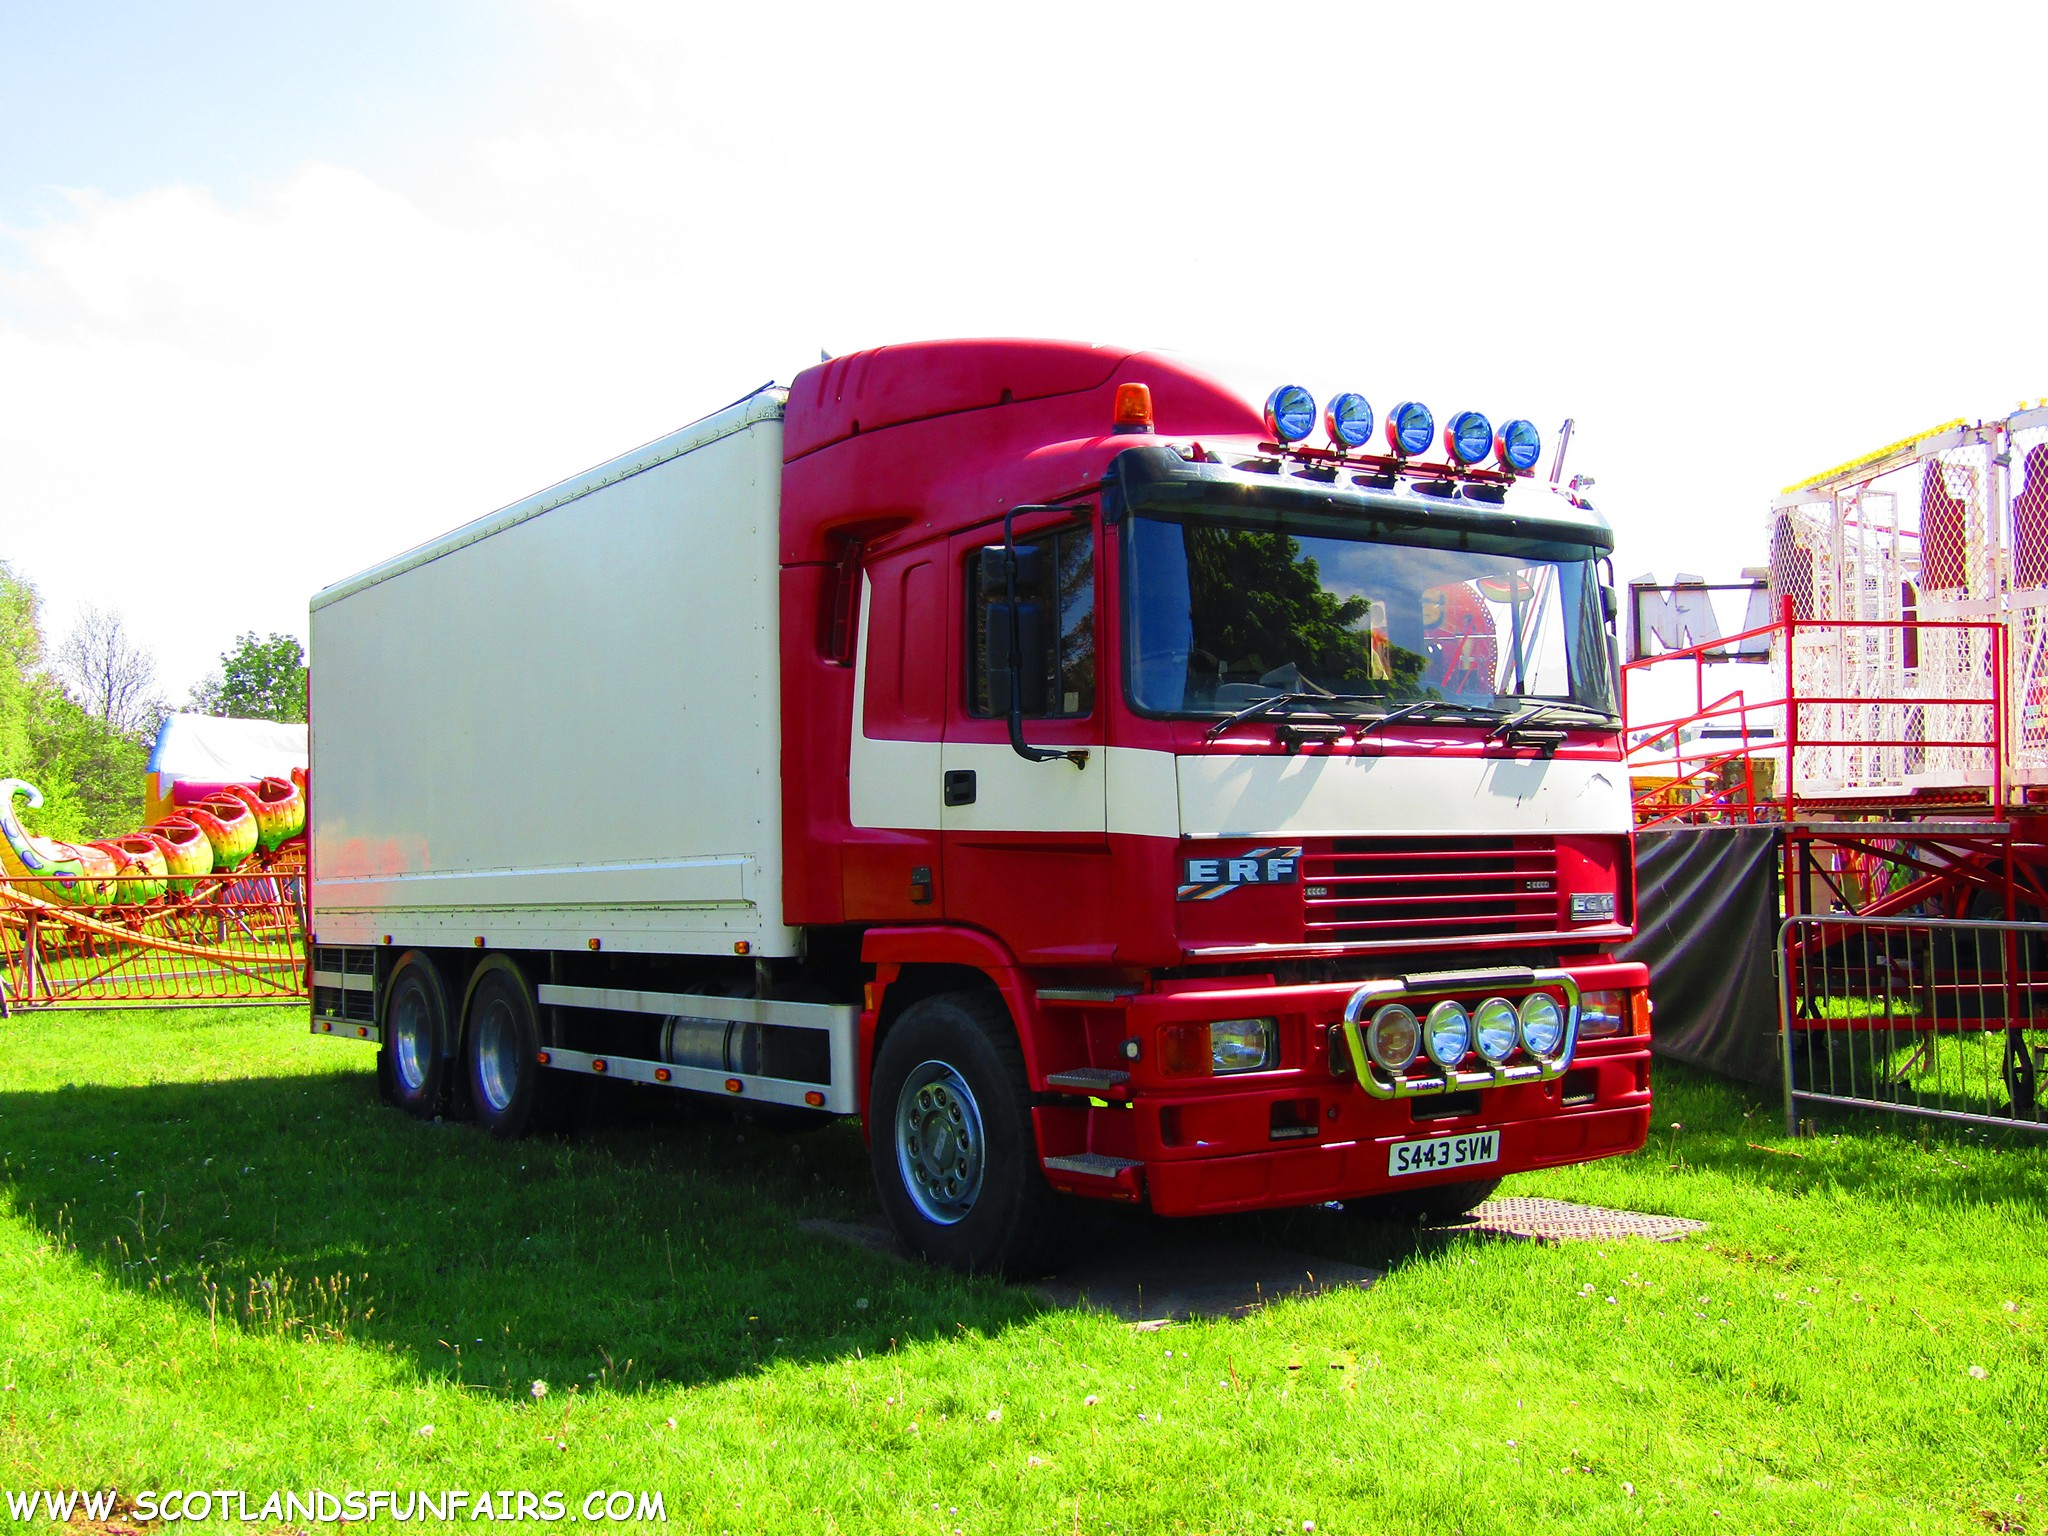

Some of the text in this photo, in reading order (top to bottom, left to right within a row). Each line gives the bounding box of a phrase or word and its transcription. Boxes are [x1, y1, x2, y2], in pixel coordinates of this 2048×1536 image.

[1189, 858, 1294, 882] ERF
[1397, 1135, 1492, 1171] S443 SVM
